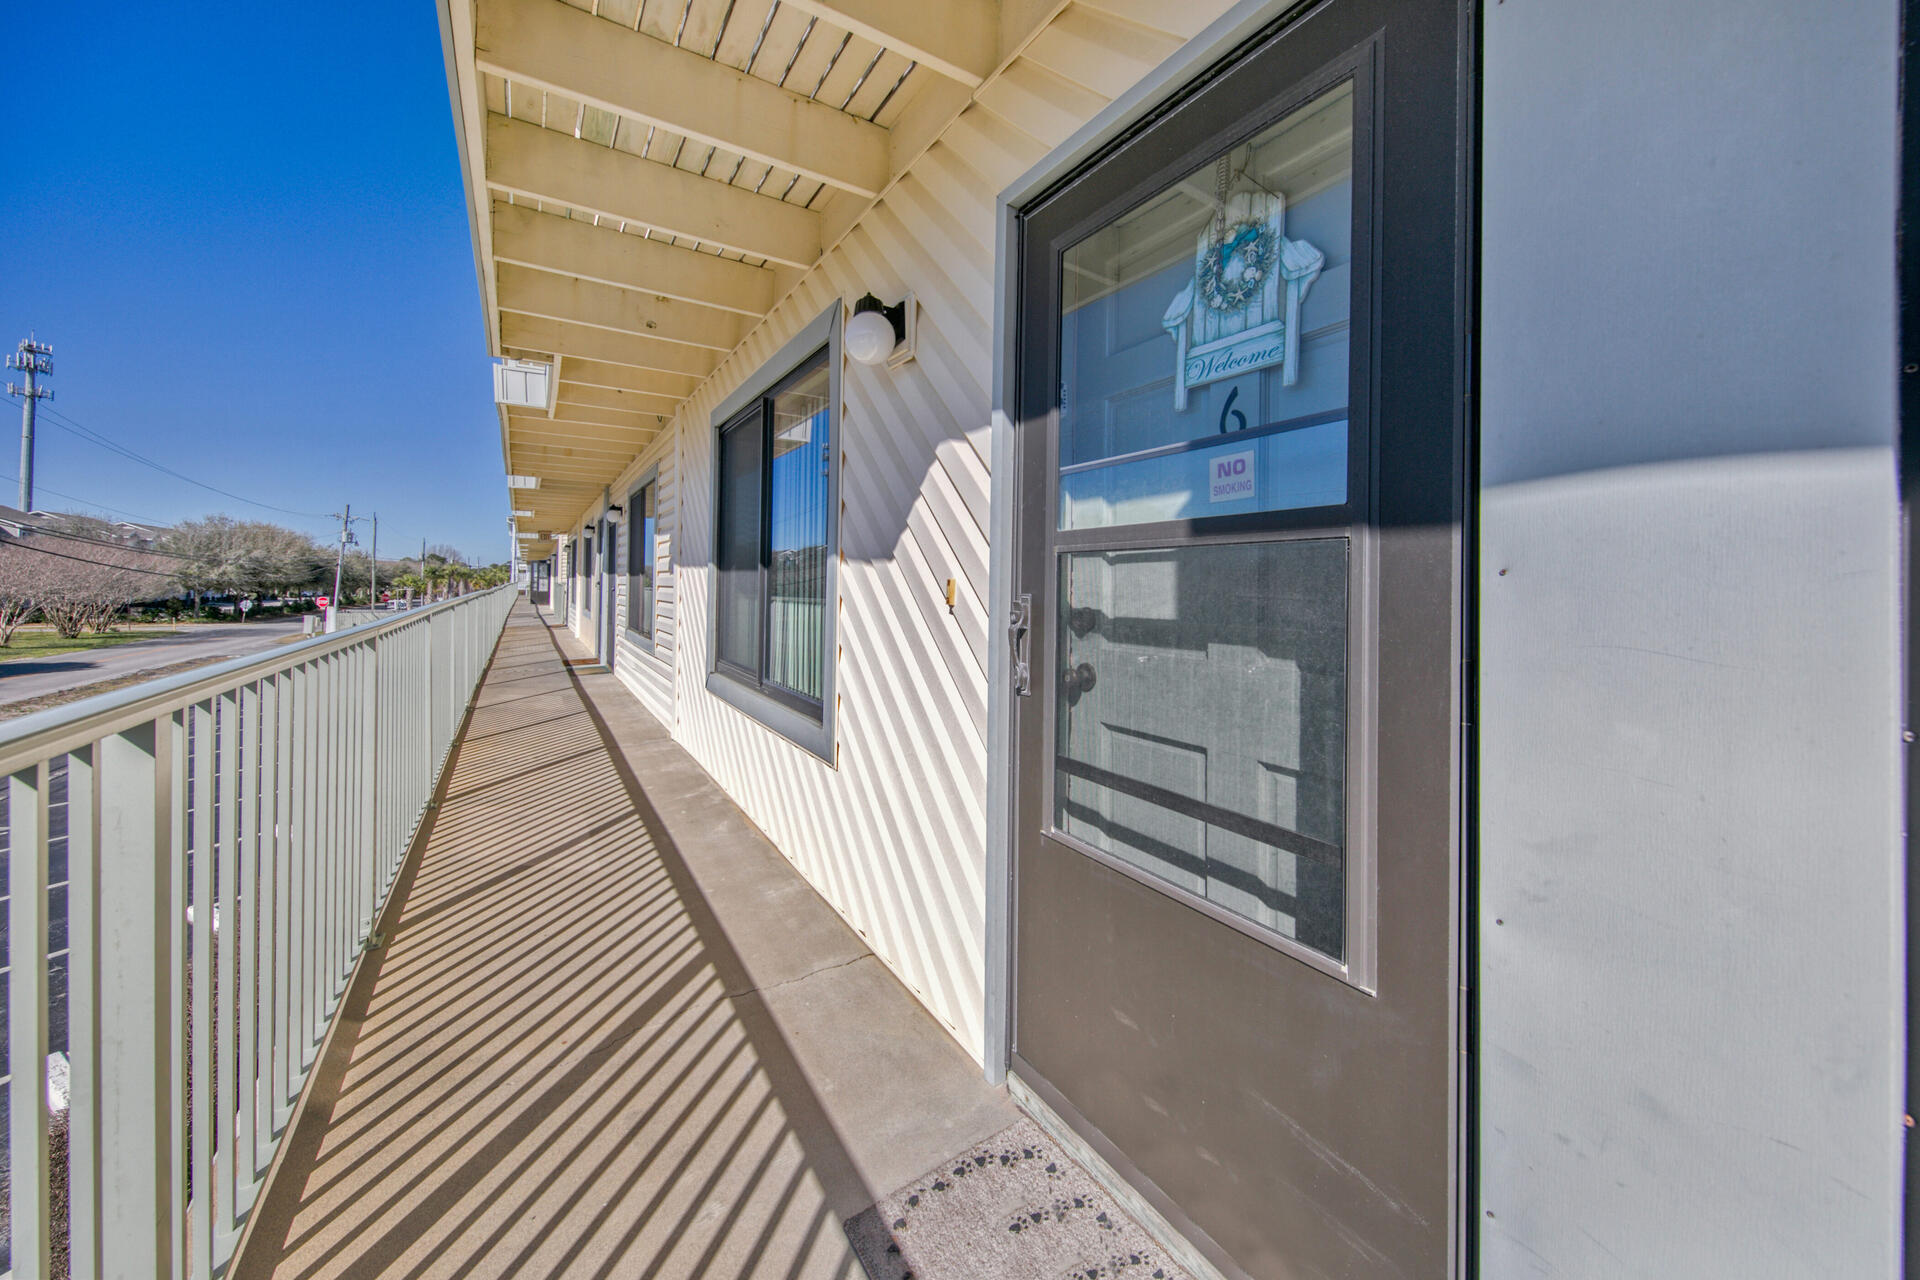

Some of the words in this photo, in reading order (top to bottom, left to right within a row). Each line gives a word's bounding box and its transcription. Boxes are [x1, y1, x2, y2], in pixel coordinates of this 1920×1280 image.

[1187, 345, 1280, 380] Welcome
[1220, 386, 1247, 433] 6
[1217, 458, 1246, 479] NO
[1213, 480, 1252, 497] SMOKING
